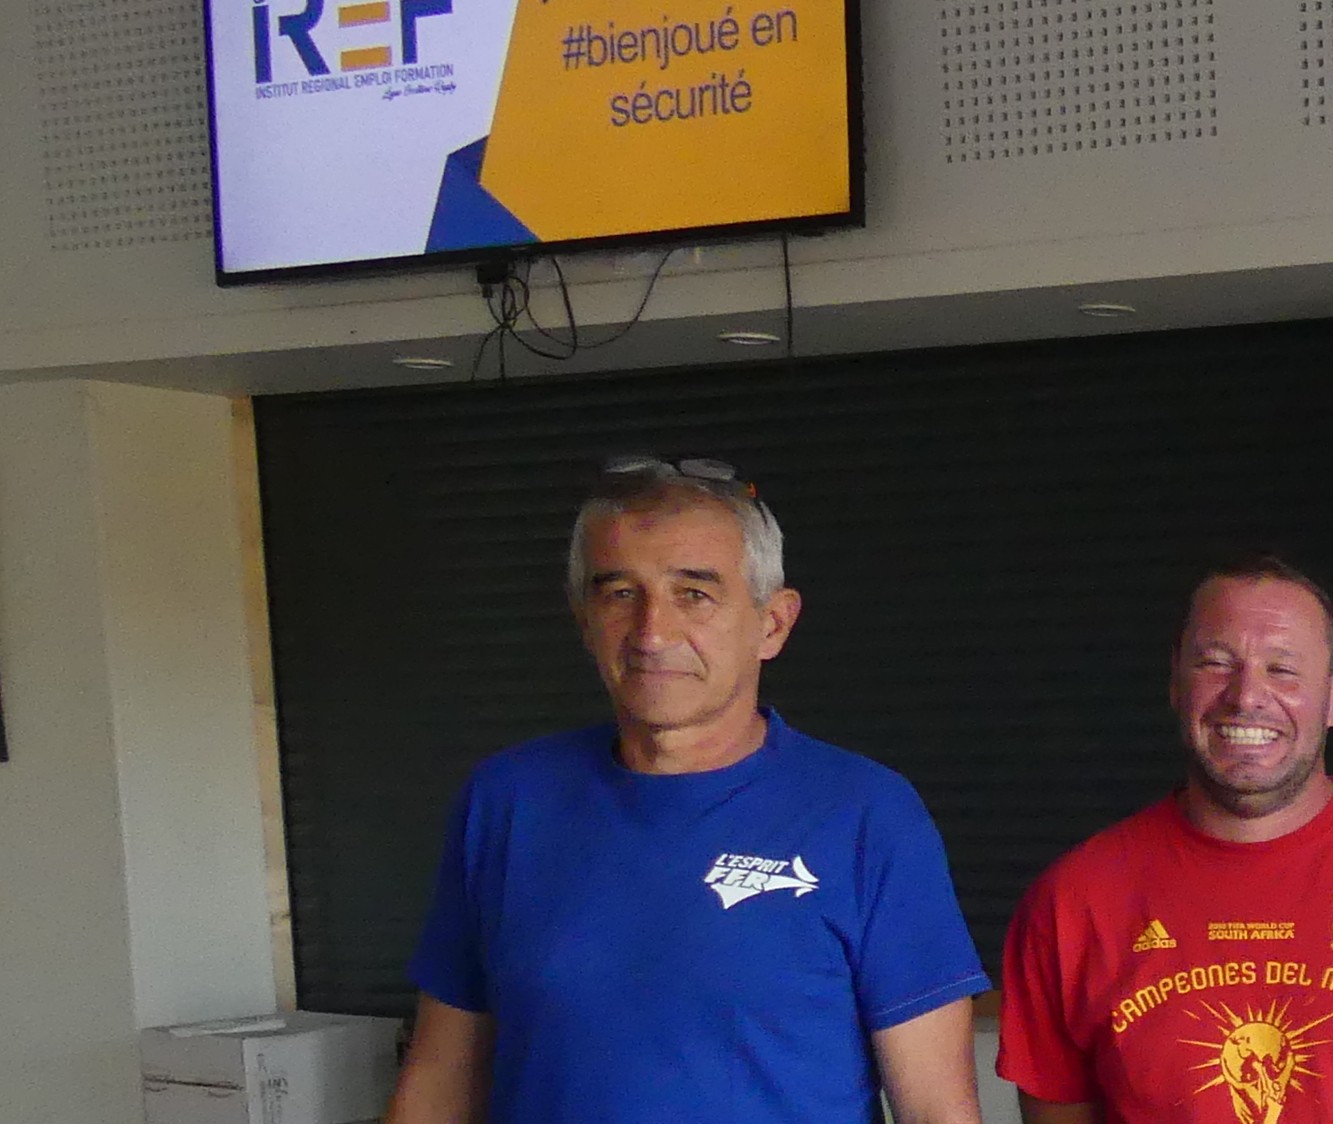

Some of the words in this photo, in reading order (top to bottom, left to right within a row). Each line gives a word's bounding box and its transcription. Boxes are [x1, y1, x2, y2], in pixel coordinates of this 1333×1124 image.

[562, 6, 740, 70] #bienjoué
[751, 9, 798, 46] en
[256, 82, 298, 100] INSTITUT
[354, 71, 392, 88] EMPLOI
[394, 64, 454, 85] FORMATION
[610, 68, 752, 127] sécurité
[715, 853, 790, 874] L'ESPRIT
[704, 866, 770, 892] FFR
[1208, 930, 1248, 941] SOUTH
[1247, 922, 1277, 930] WORLD
[1132, 937, 1177, 953] adidas
[1112, 961, 1257, 1034] CAMPEONES
[1266, 961, 1312, 987] DEL
